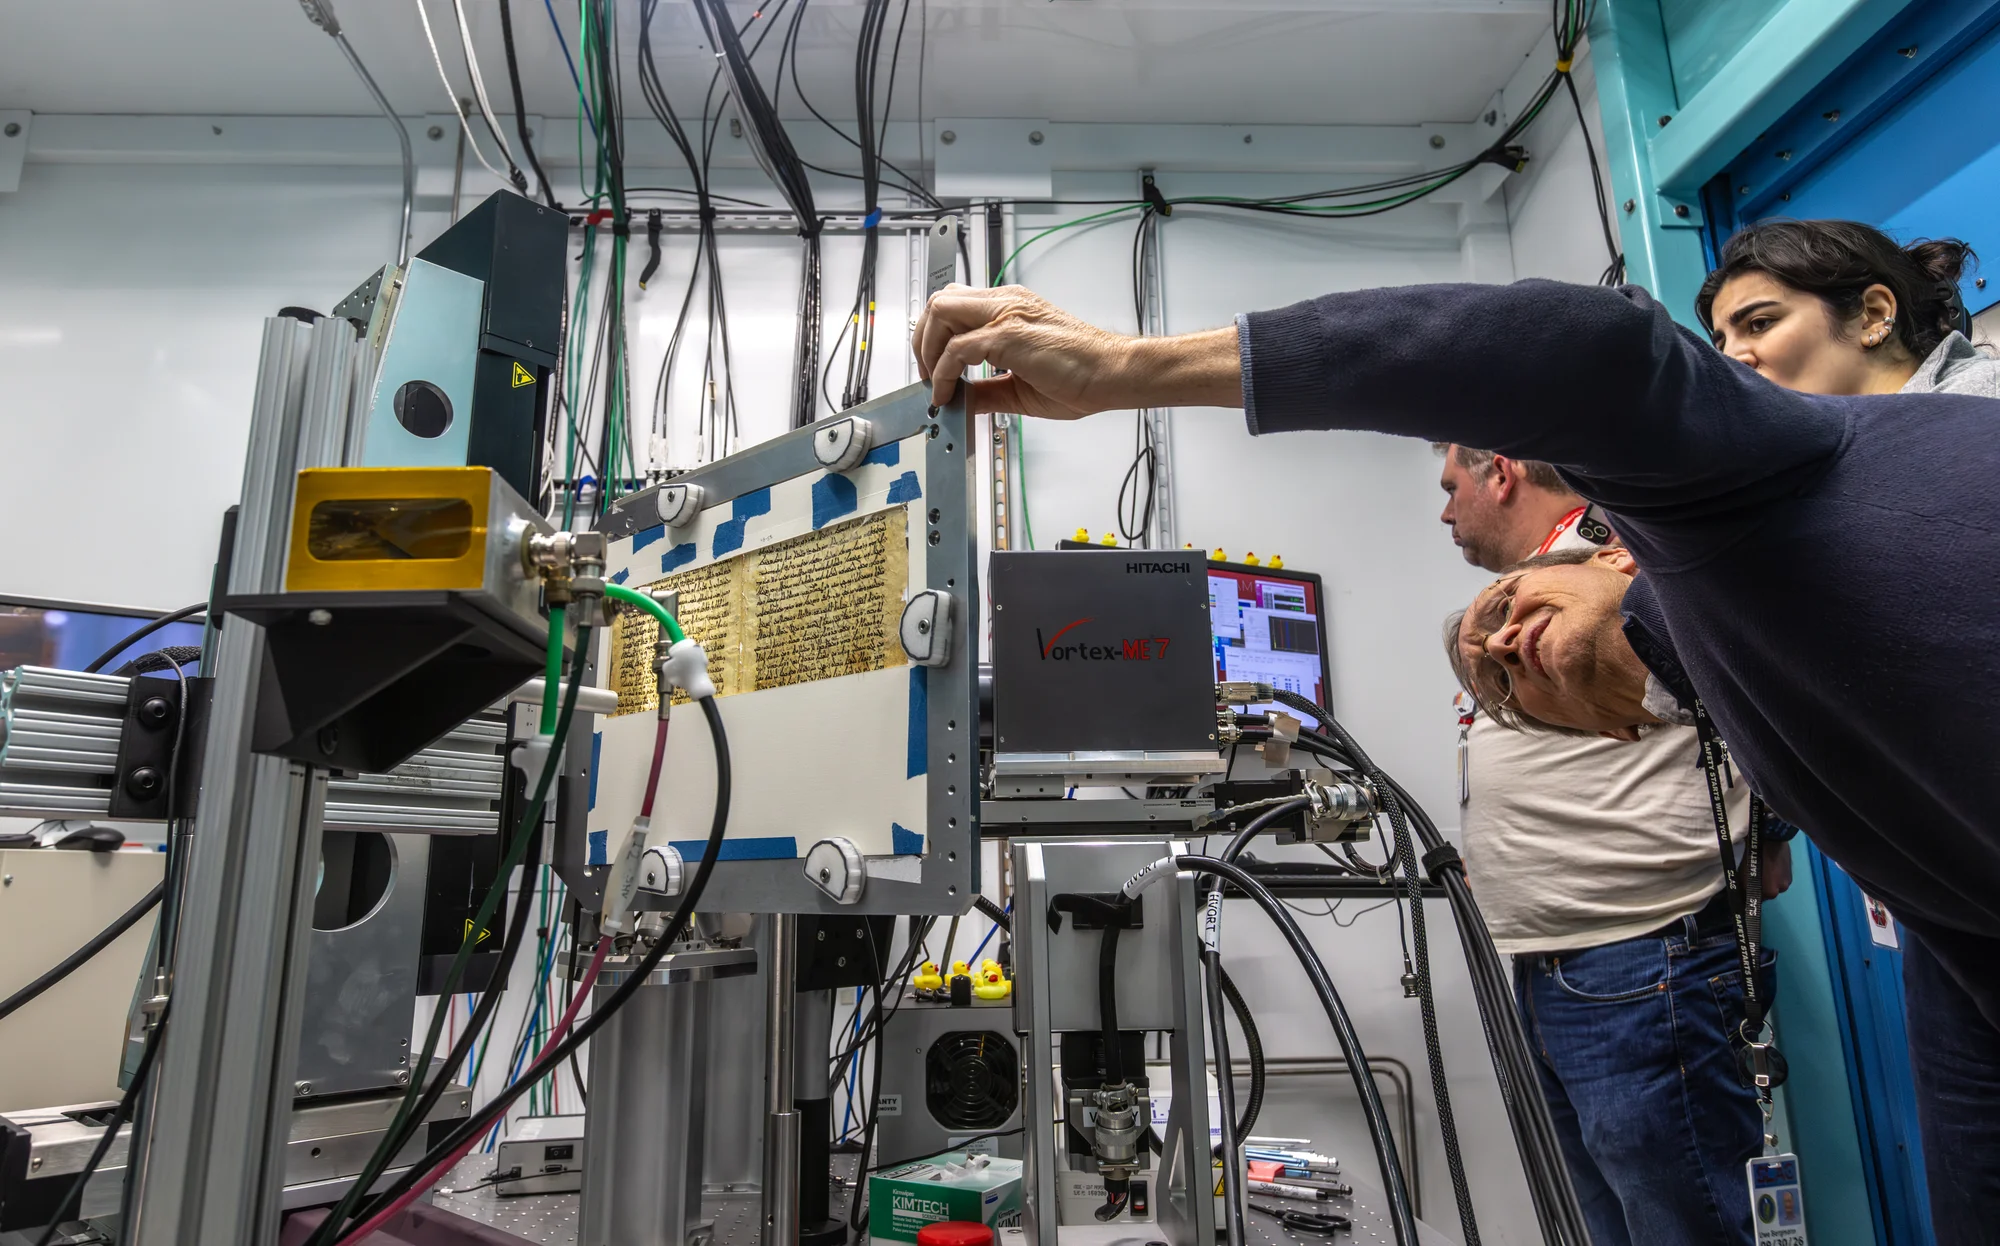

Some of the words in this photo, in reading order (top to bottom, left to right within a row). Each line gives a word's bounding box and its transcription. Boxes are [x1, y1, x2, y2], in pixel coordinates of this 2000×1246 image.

[1126, 562, 1191, 574] HITACHI
[1704, 741, 1715, 770] SAFETY
[1709, 772, 1721, 801] STARTS
[1715, 803, 1725, 823] WITH
[1718, 825, 1728, 841] YOU
[1751, 825, 1759, 849] STARTS
[1750, 850, 1758, 877] SAFETY
[1205, 894, 1220, 932] HVORT
[1735, 914, 1746, 944] SAFETY
[1205, 941, 1216, 949] 7
[1740, 946, 1750, 977] STARTS
[1745, 978, 1755, 998] WITH
[893, 1196, 949, 1215] KIMTECH
